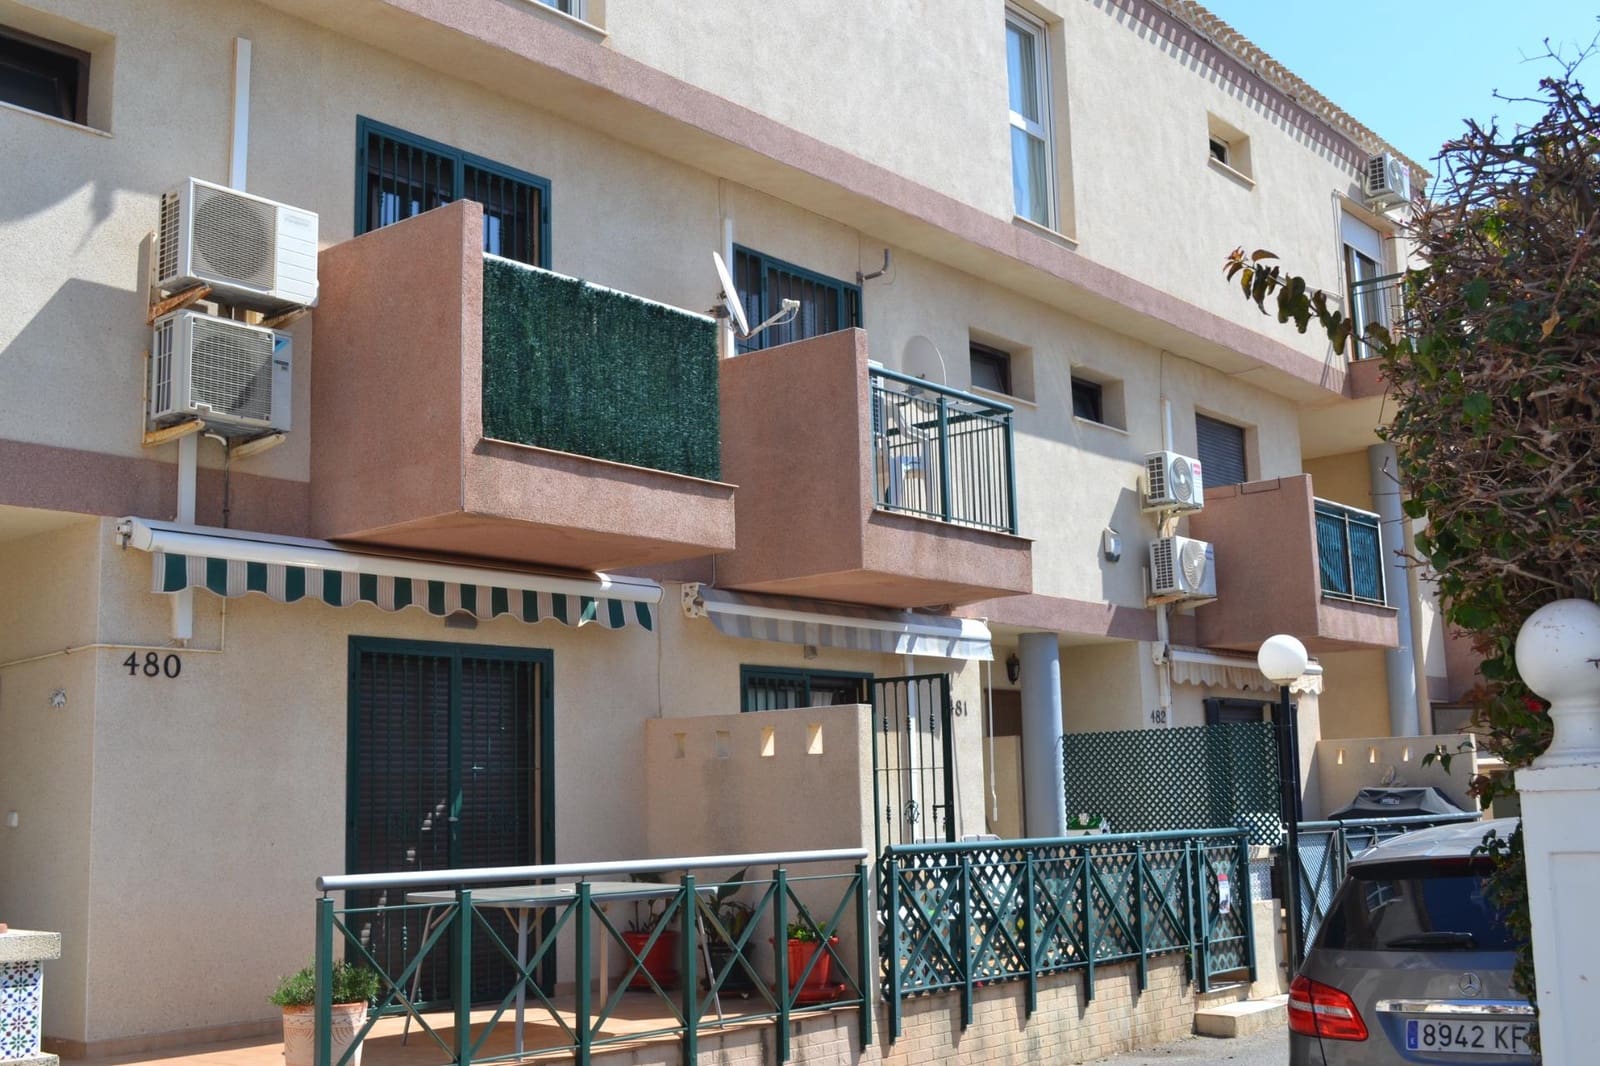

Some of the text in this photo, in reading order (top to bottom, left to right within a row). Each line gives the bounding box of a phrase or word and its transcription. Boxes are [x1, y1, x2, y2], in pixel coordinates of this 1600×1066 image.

[123, 651, 180, 678] 480
[1150, 709, 1166, 724] 482
[1423, 1024, 1484, 1048] 8942
